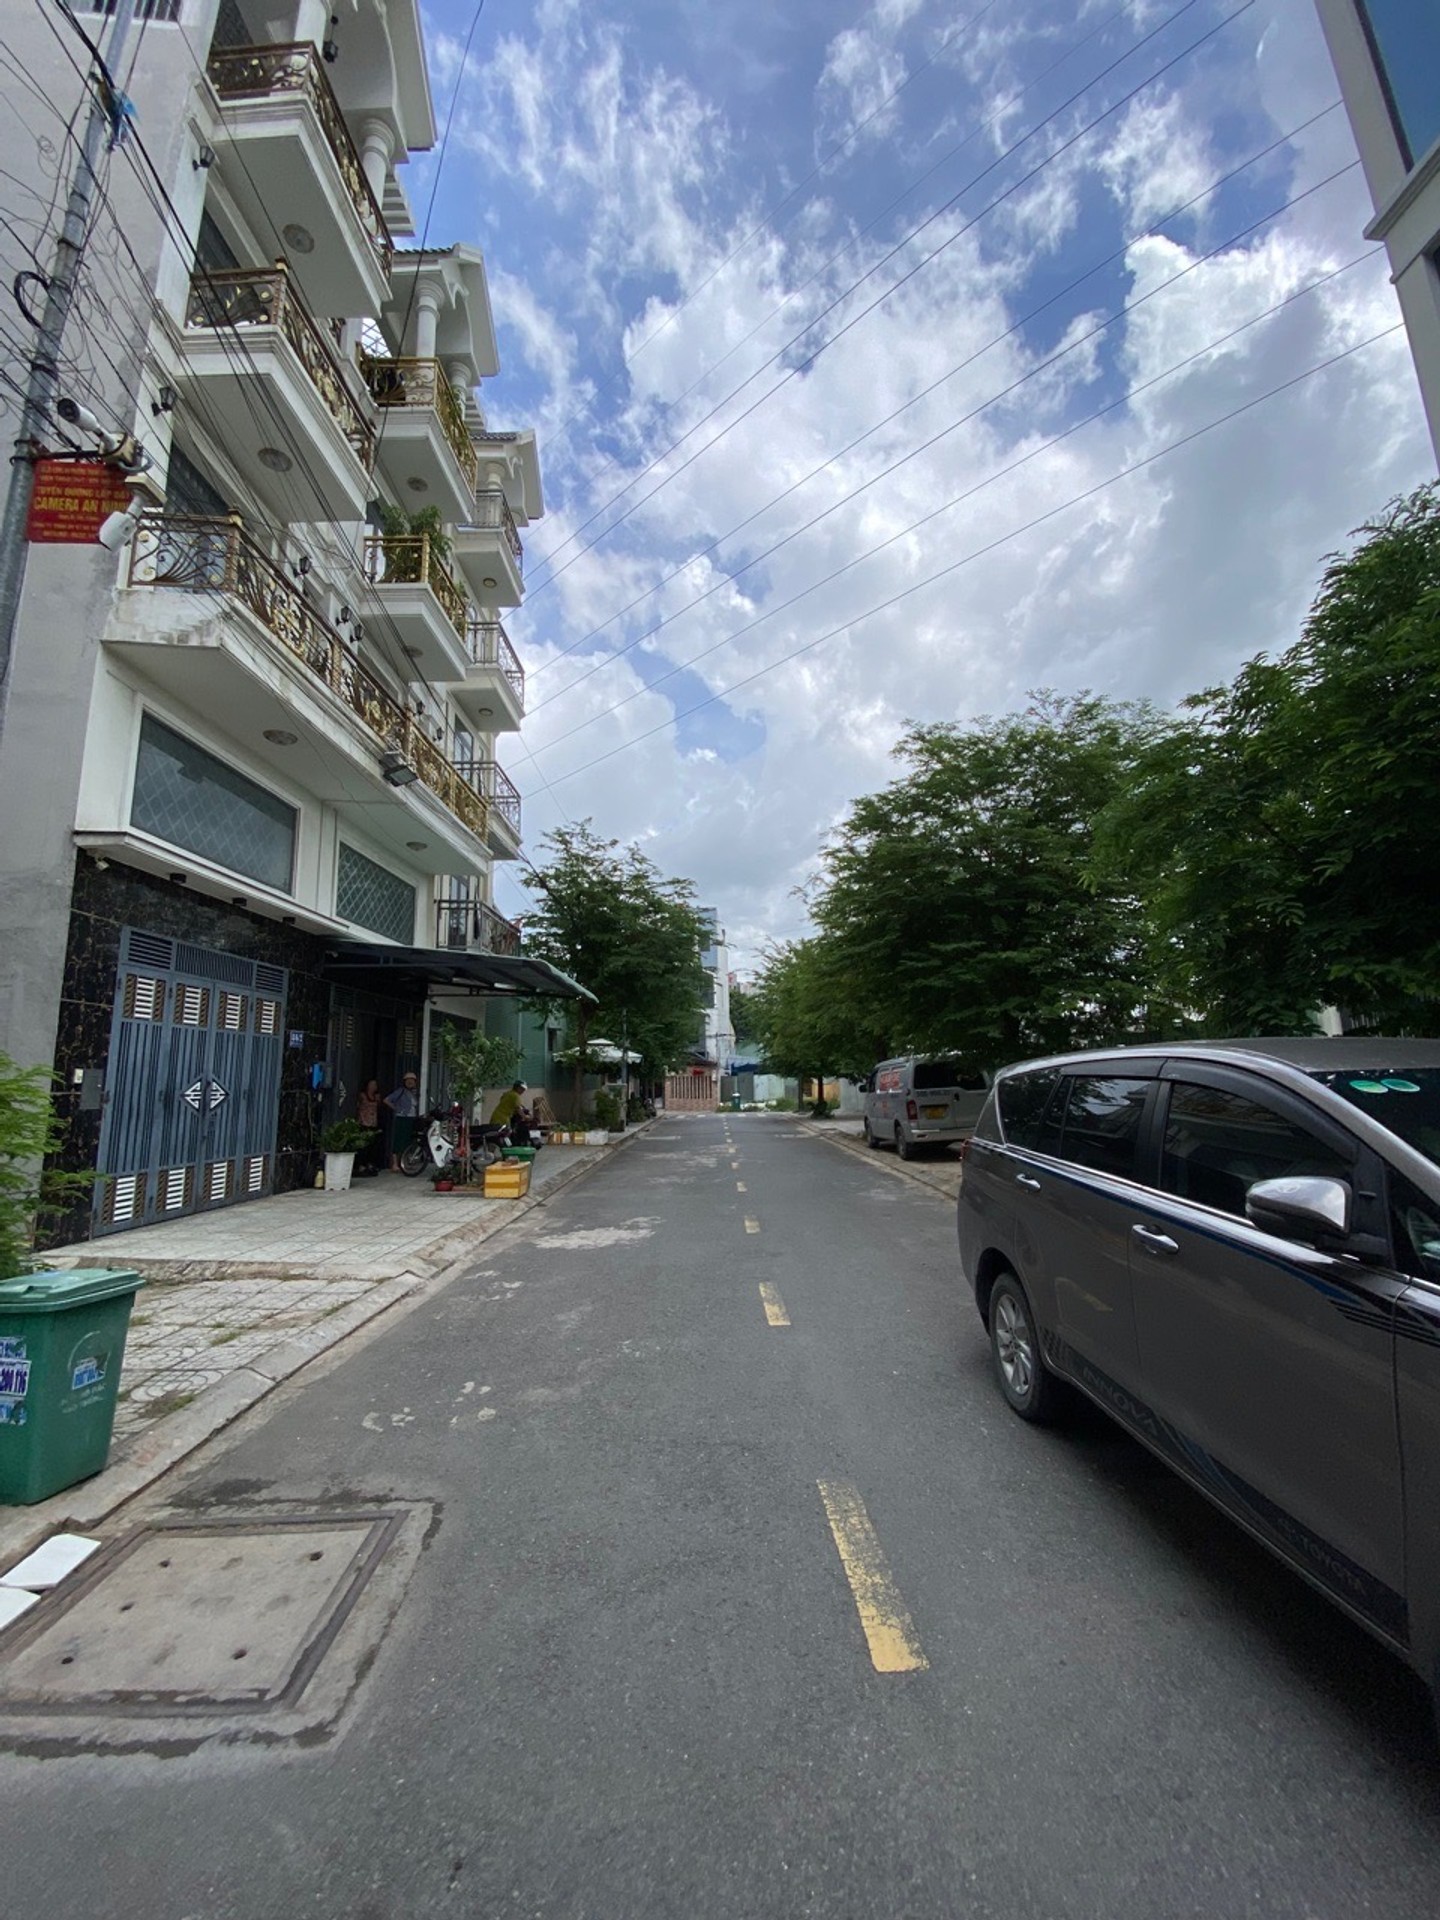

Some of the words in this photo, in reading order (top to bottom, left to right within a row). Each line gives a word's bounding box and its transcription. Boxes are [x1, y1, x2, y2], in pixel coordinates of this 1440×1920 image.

[34, 496, 79, 511] CAMERA
[82, 499, 98, 513] AN
[1083, 1366, 1158, 1436] INNOVA
